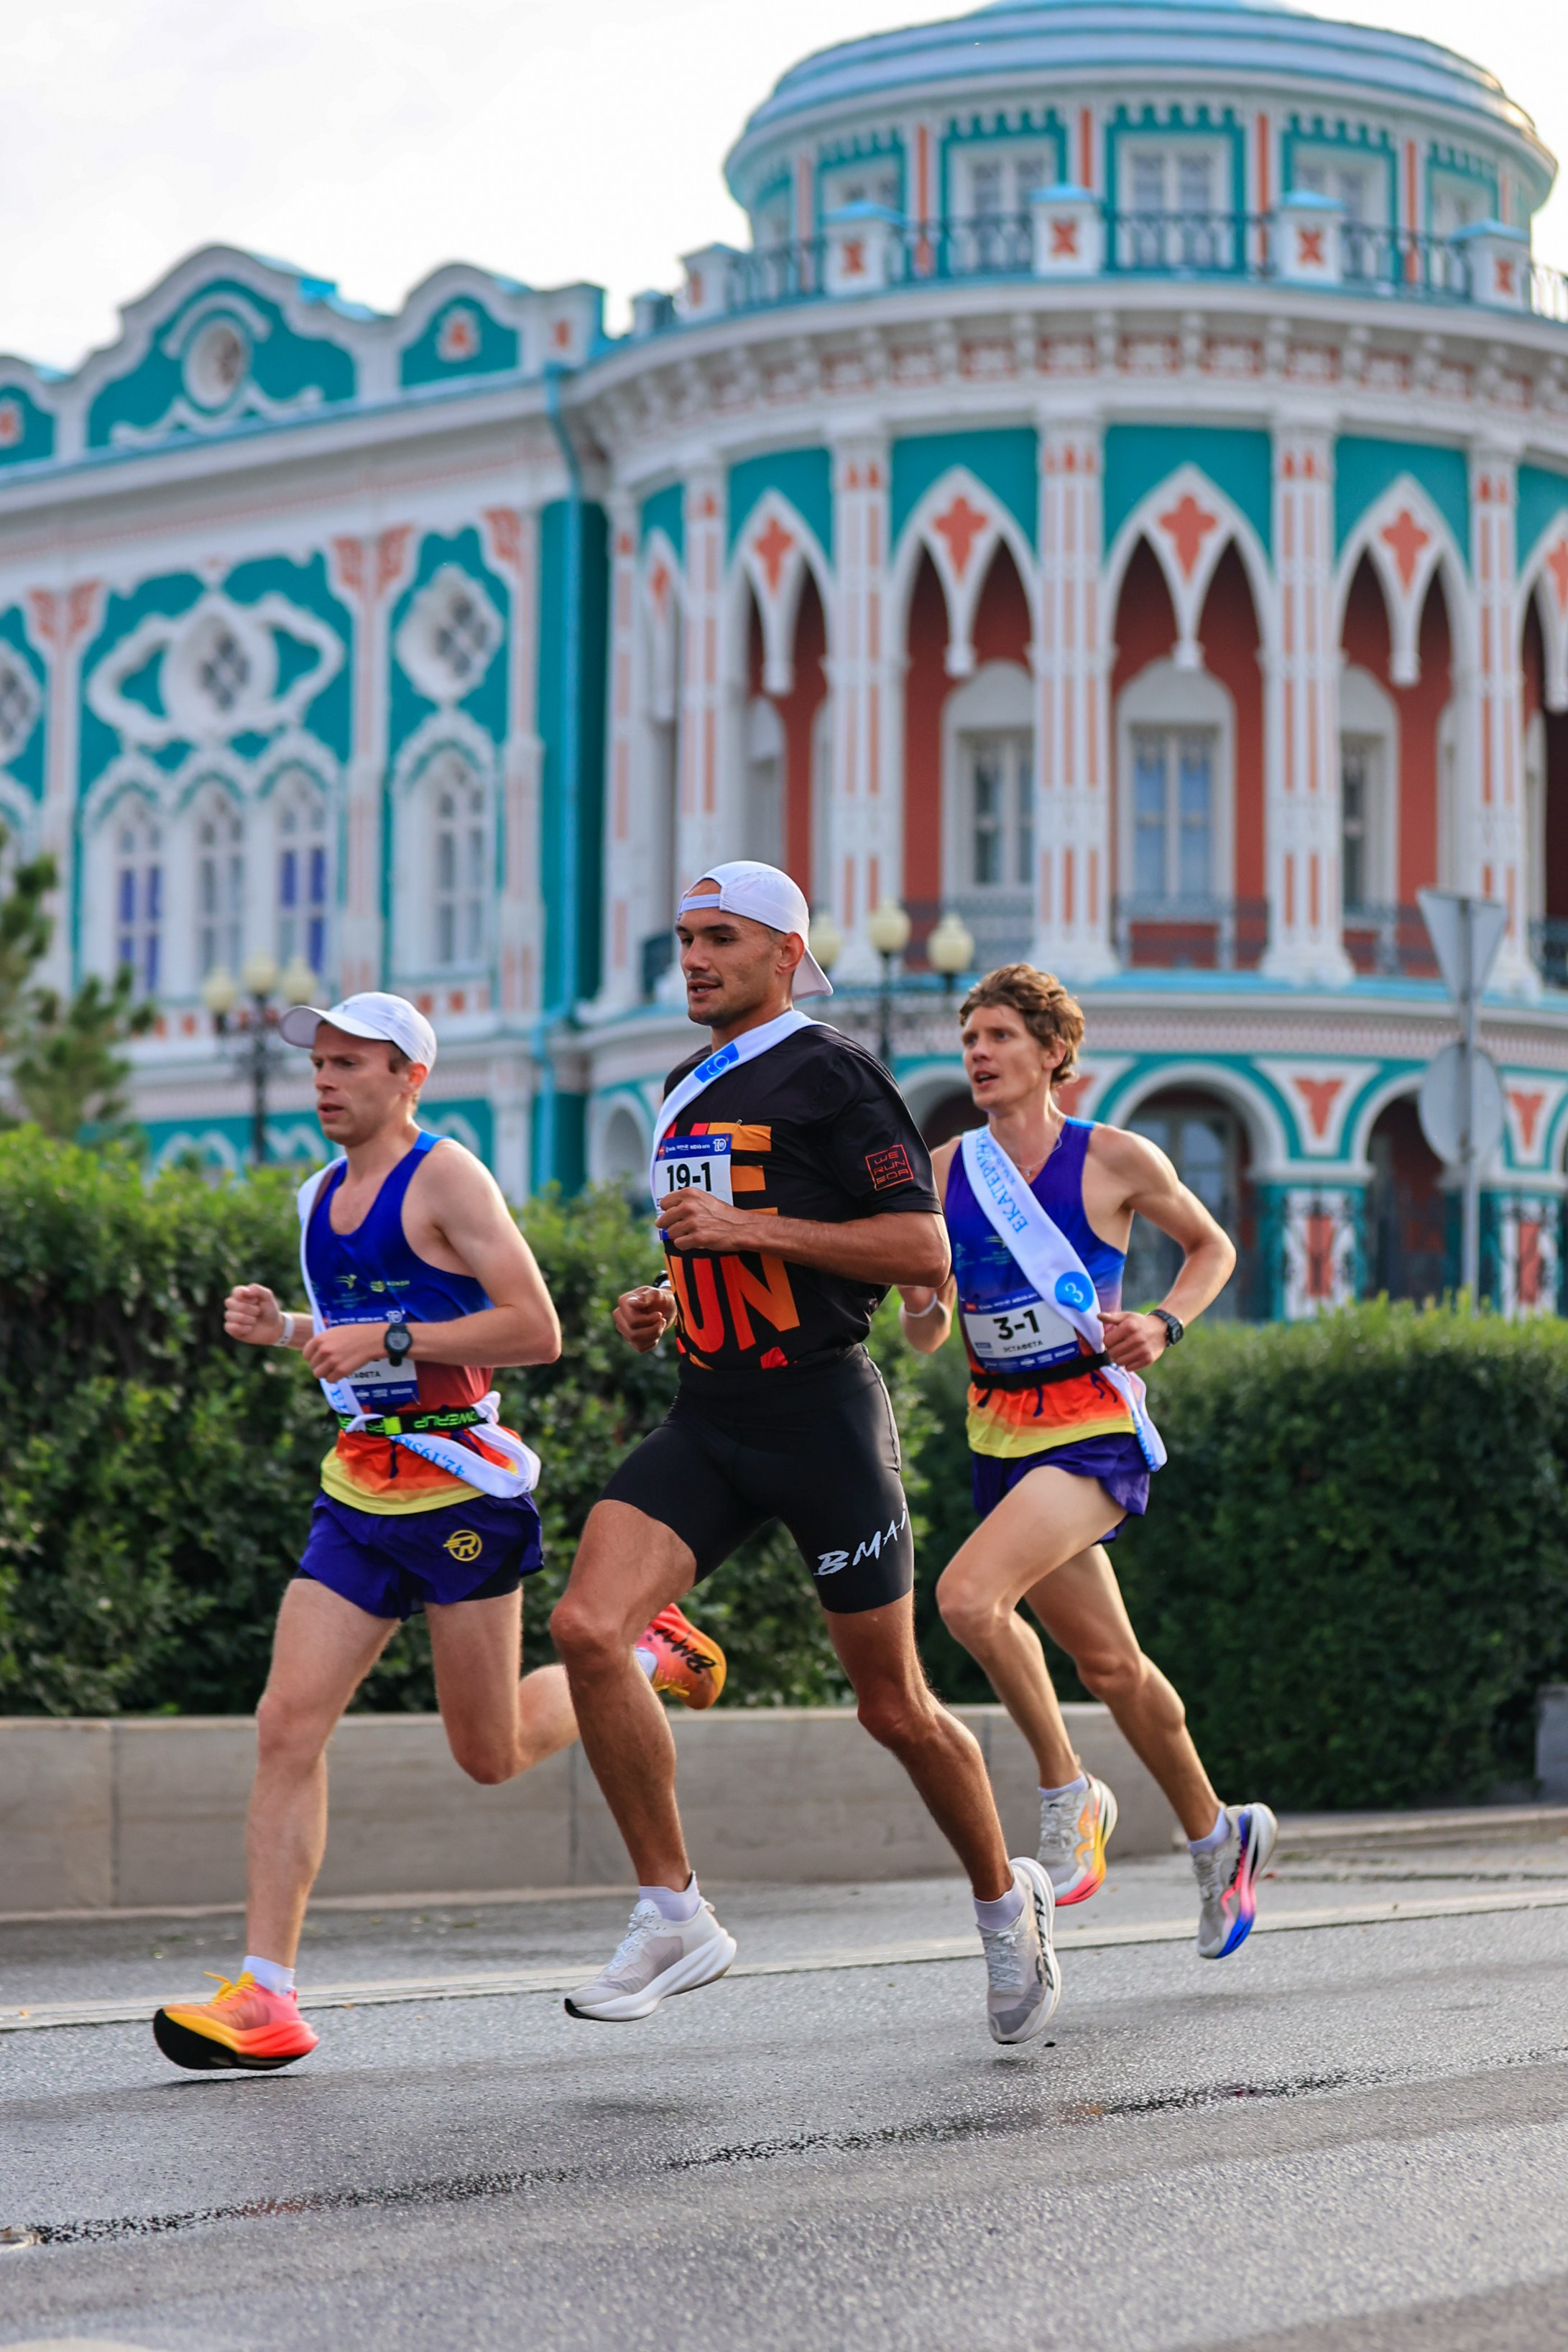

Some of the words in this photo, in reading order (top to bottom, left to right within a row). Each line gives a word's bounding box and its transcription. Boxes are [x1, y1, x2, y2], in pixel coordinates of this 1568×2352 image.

[872, 1159, 906, 1176] RUN
[874, 1150, 899, 1165] WE
[666, 1161, 712, 1193] 19-1
[665, 1253, 801, 1353] UN
[1064, 1282, 1084, 1304] 3
[992, 1309, 1041, 1341] 3-1
